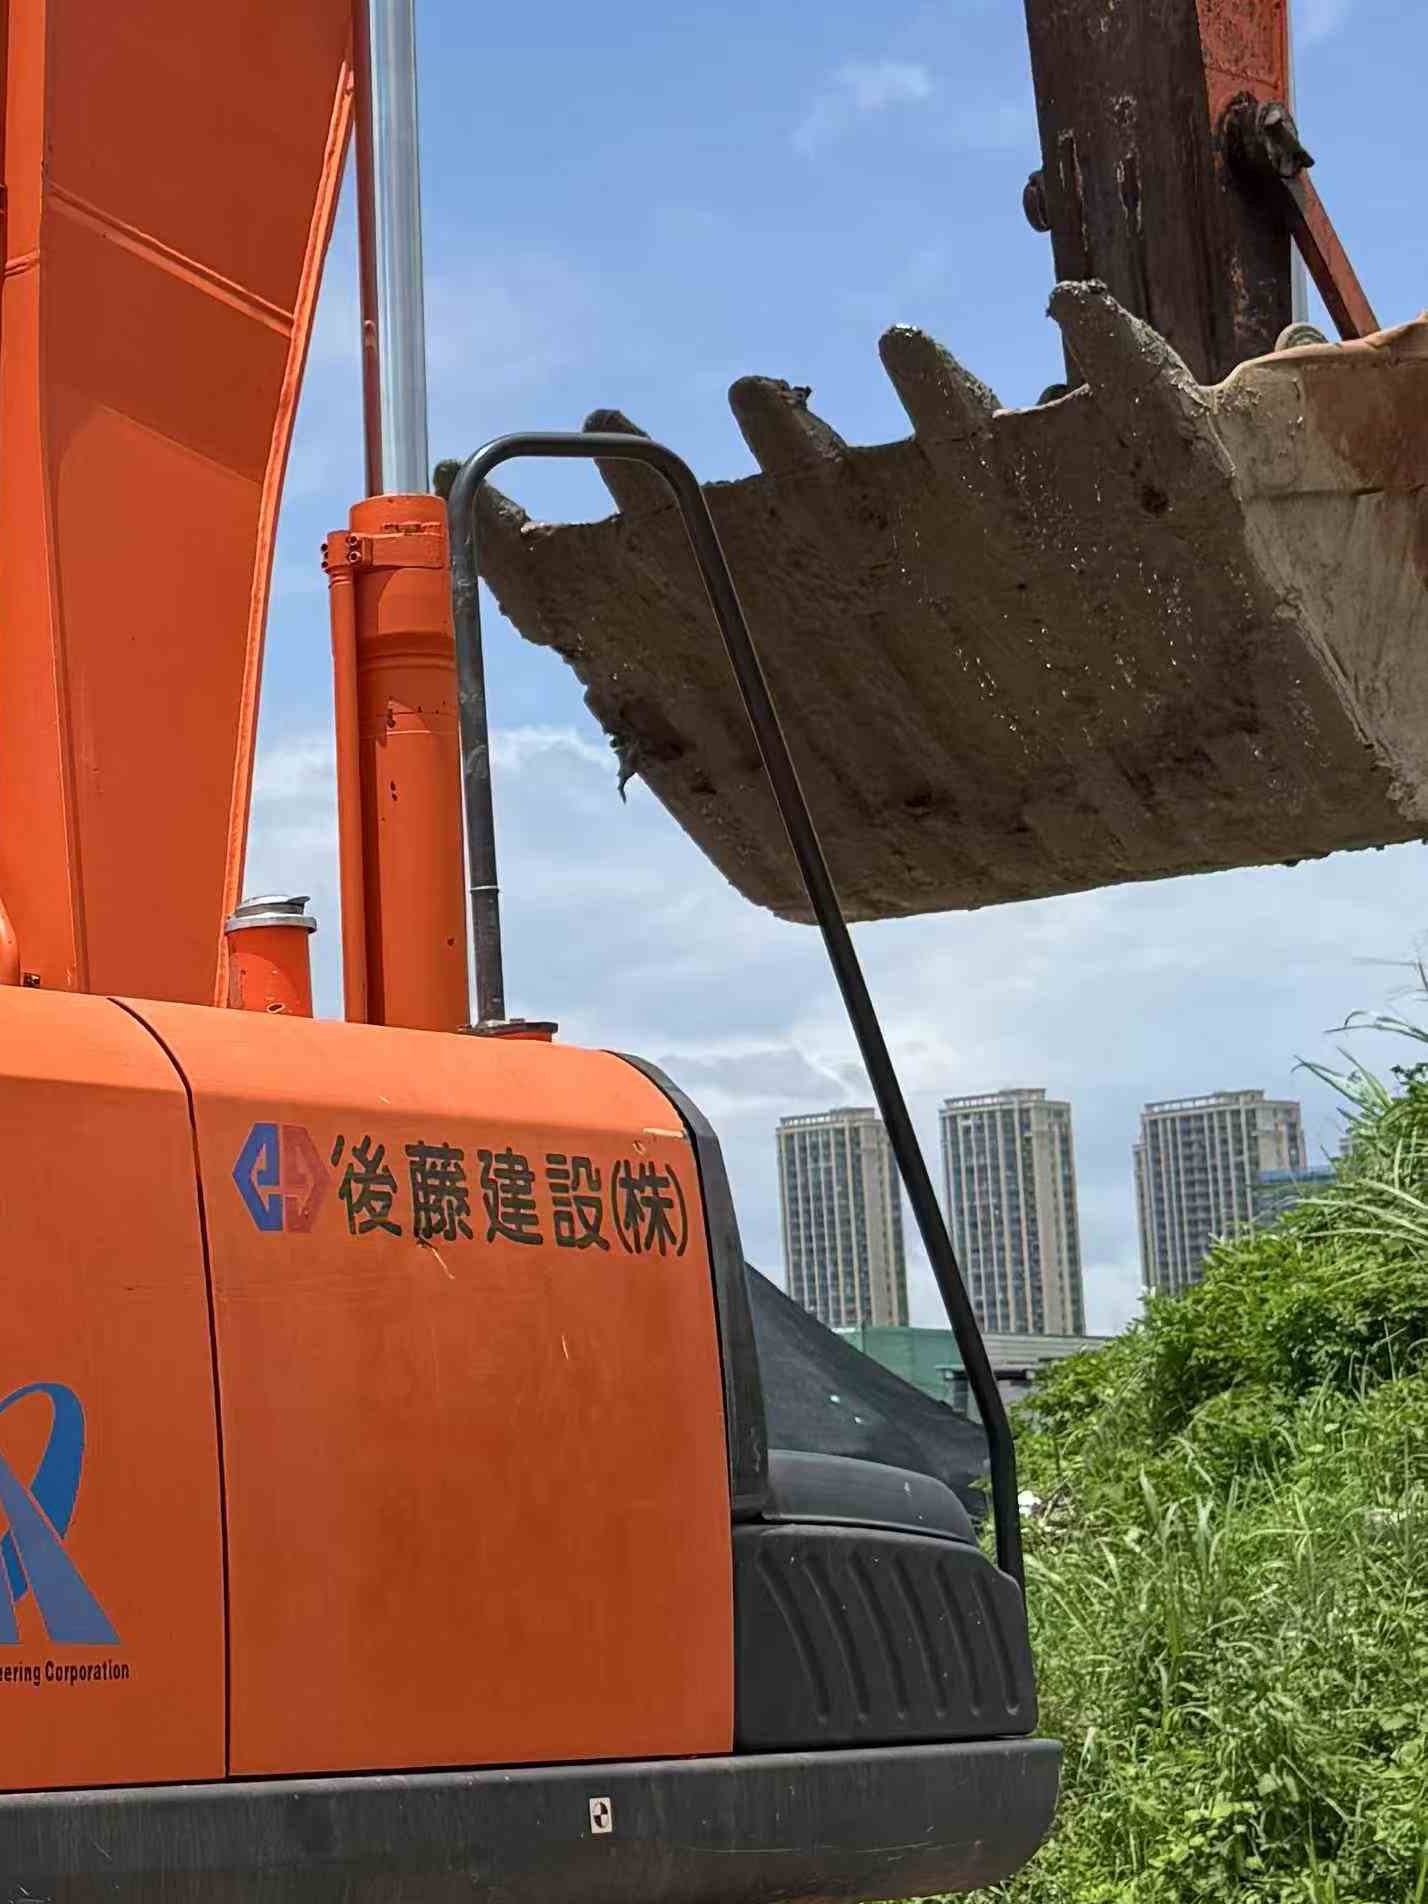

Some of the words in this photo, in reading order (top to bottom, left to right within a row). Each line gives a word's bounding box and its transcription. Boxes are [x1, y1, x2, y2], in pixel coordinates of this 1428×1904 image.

[330, 1135, 688, 1256] 後藤建設(株)
[44, 1659, 130, 1685] Corporation
